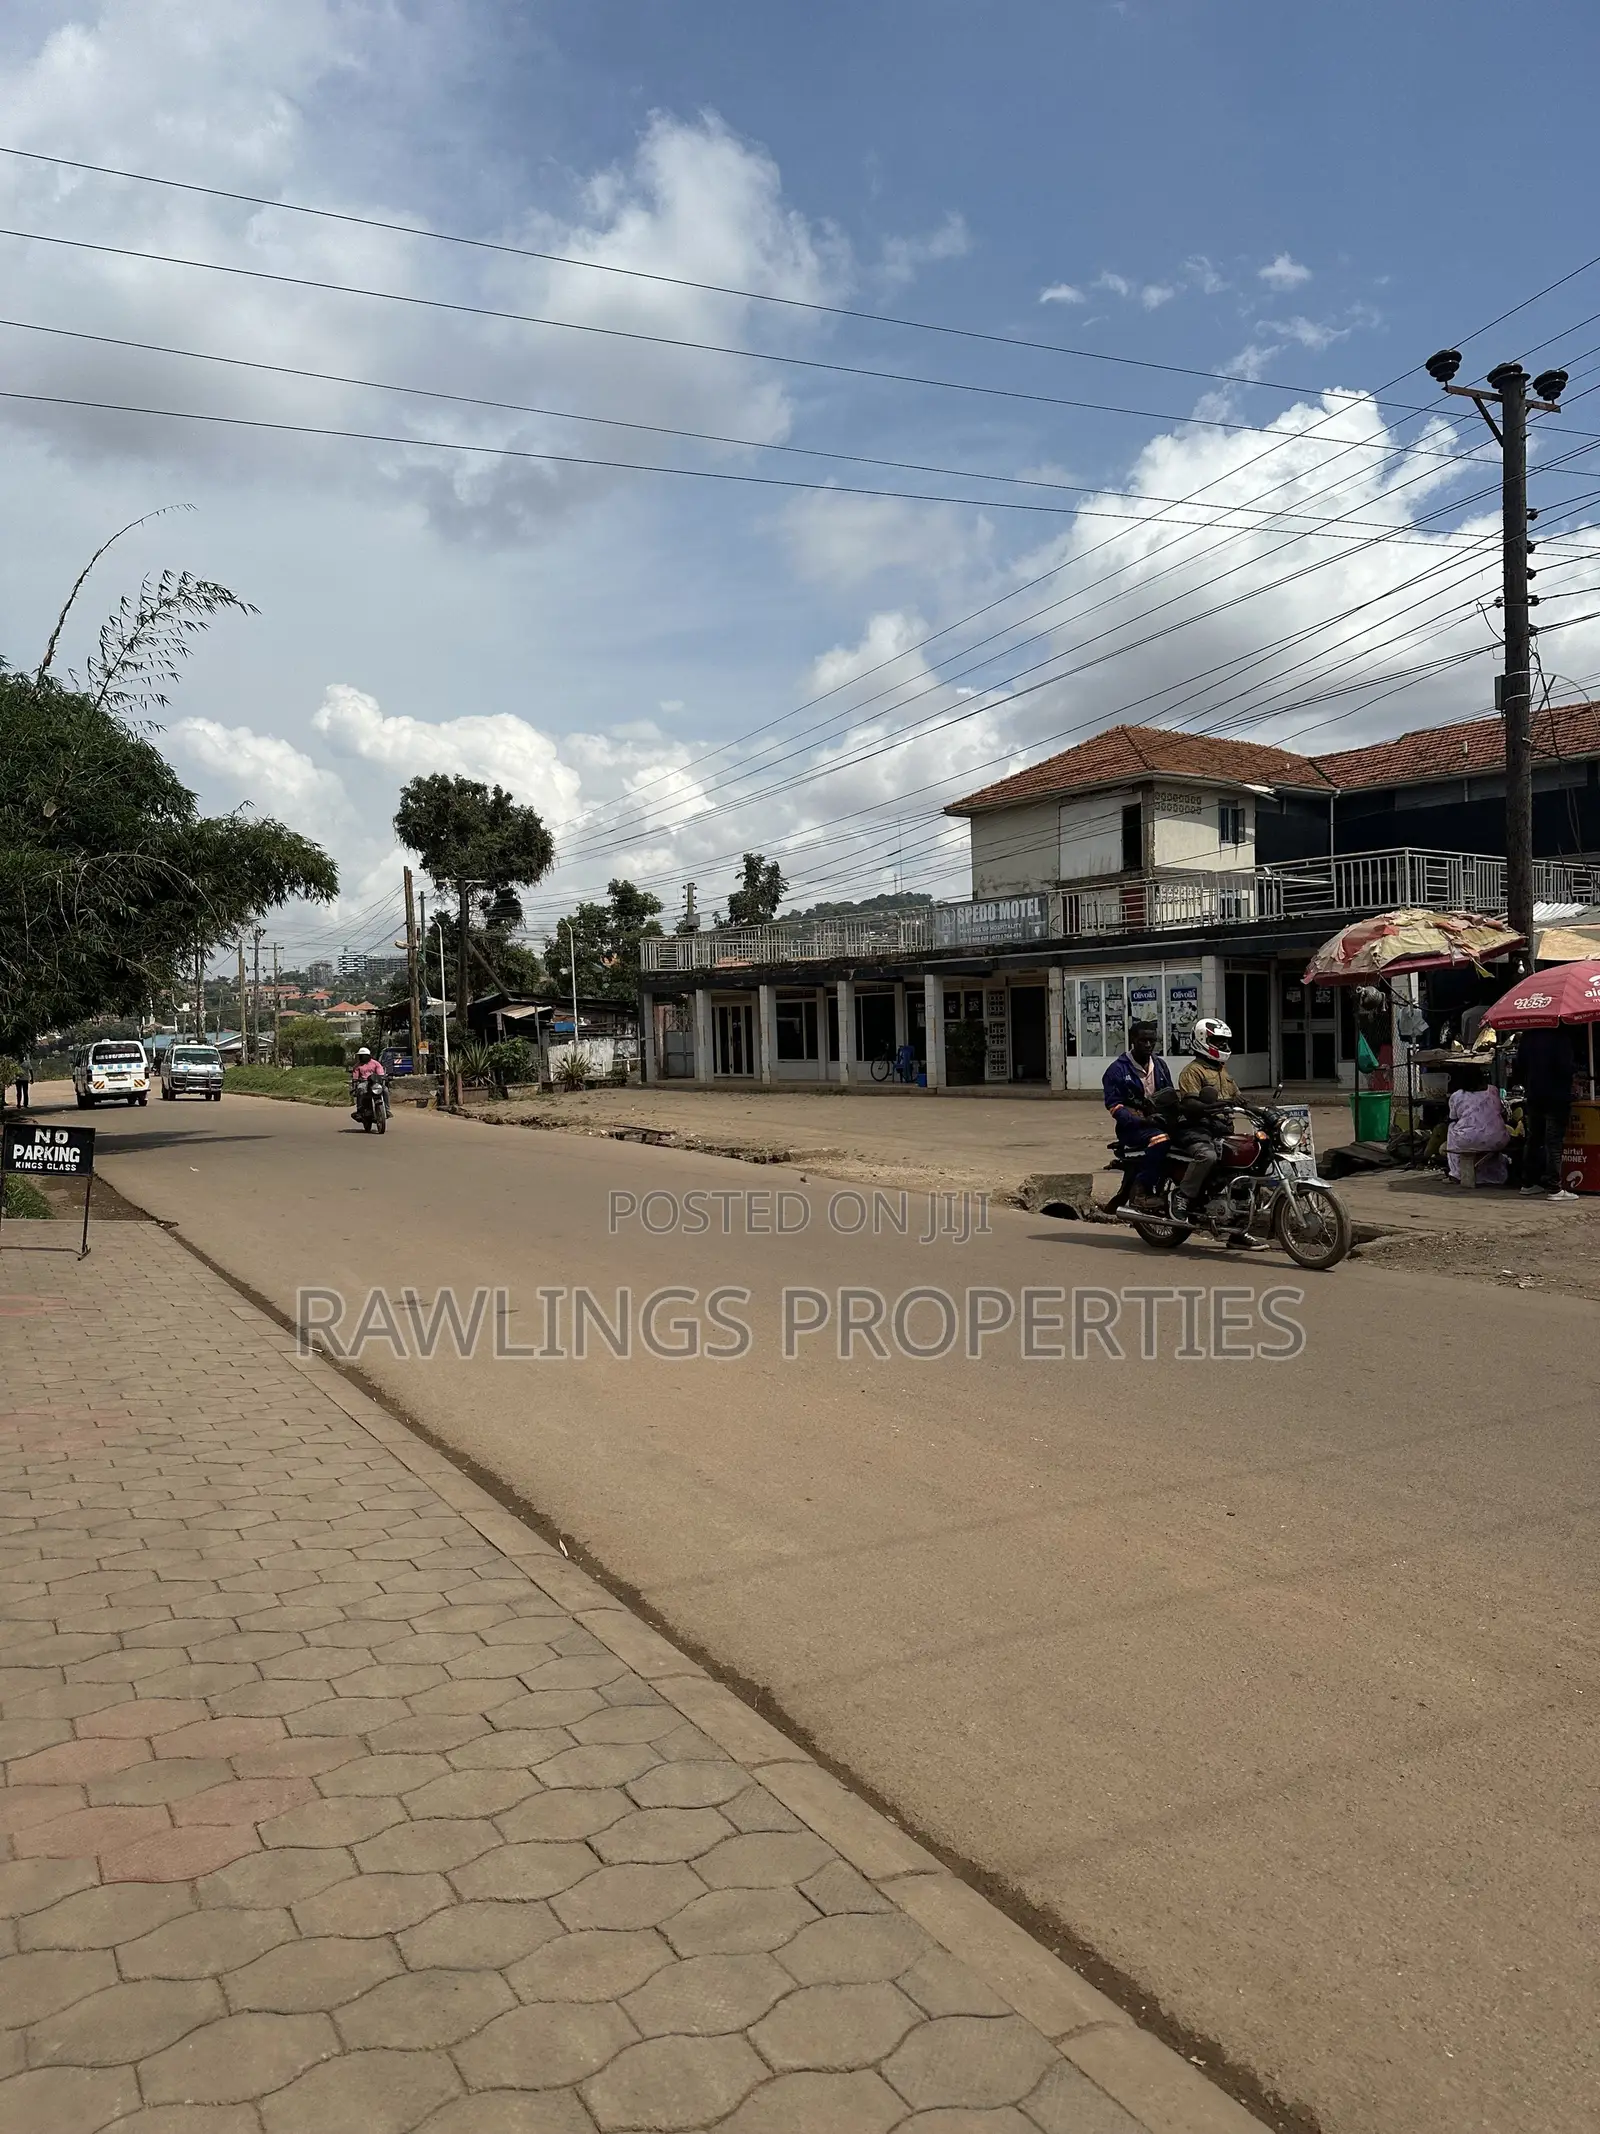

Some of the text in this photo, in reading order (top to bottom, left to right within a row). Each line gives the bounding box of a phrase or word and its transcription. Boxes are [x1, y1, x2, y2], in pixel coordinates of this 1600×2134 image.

[957, 898, 1041, 925] SPEDO MOTEL
[990, 923, 1022, 931] HOSPITALITY
[35, 1128, 69, 1144] NO
[13, 1144, 80, 1163] PARKING
[1563, 1147, 1583, 1156] airtel
[1561, 1155, 1588, 1163] MONEY
[15, 1161, 43, 1170] KINGS
